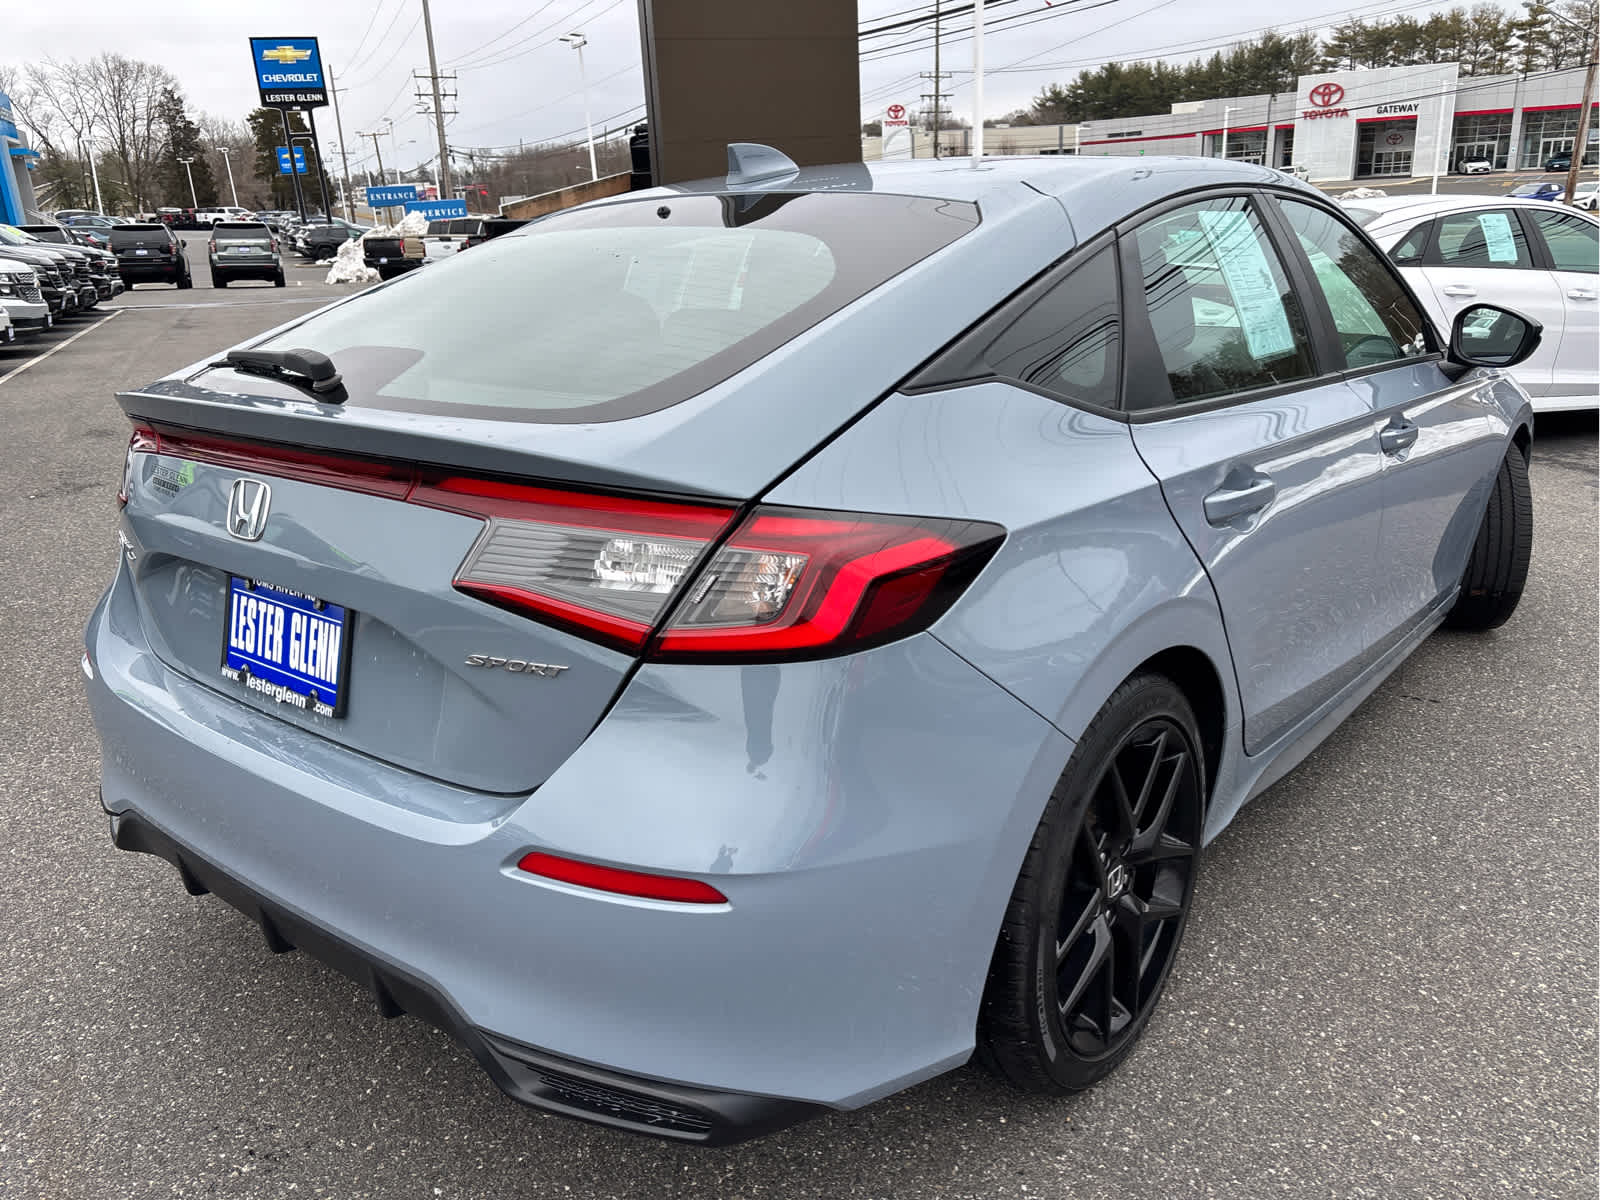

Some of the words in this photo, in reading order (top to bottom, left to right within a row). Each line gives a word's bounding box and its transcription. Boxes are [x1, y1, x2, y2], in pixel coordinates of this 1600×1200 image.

[262, 73, 318, 82] CHEVROLET
[265, 94, 296, 102] LESTER
[296, 93, 324, 101] GLENN
[1302, 108, 1349, 120] TOYOTA
[1376, 103, 1420, 115] GATEWAY
[369, 191, 416, 201] ENTRANCE
[230, 593, 285, 664] LESTER
[289, 611, 342, 685] GLENN
[464, 654, 569, 679] SPORT
[246, 673, 307, 709] lesterglenn
